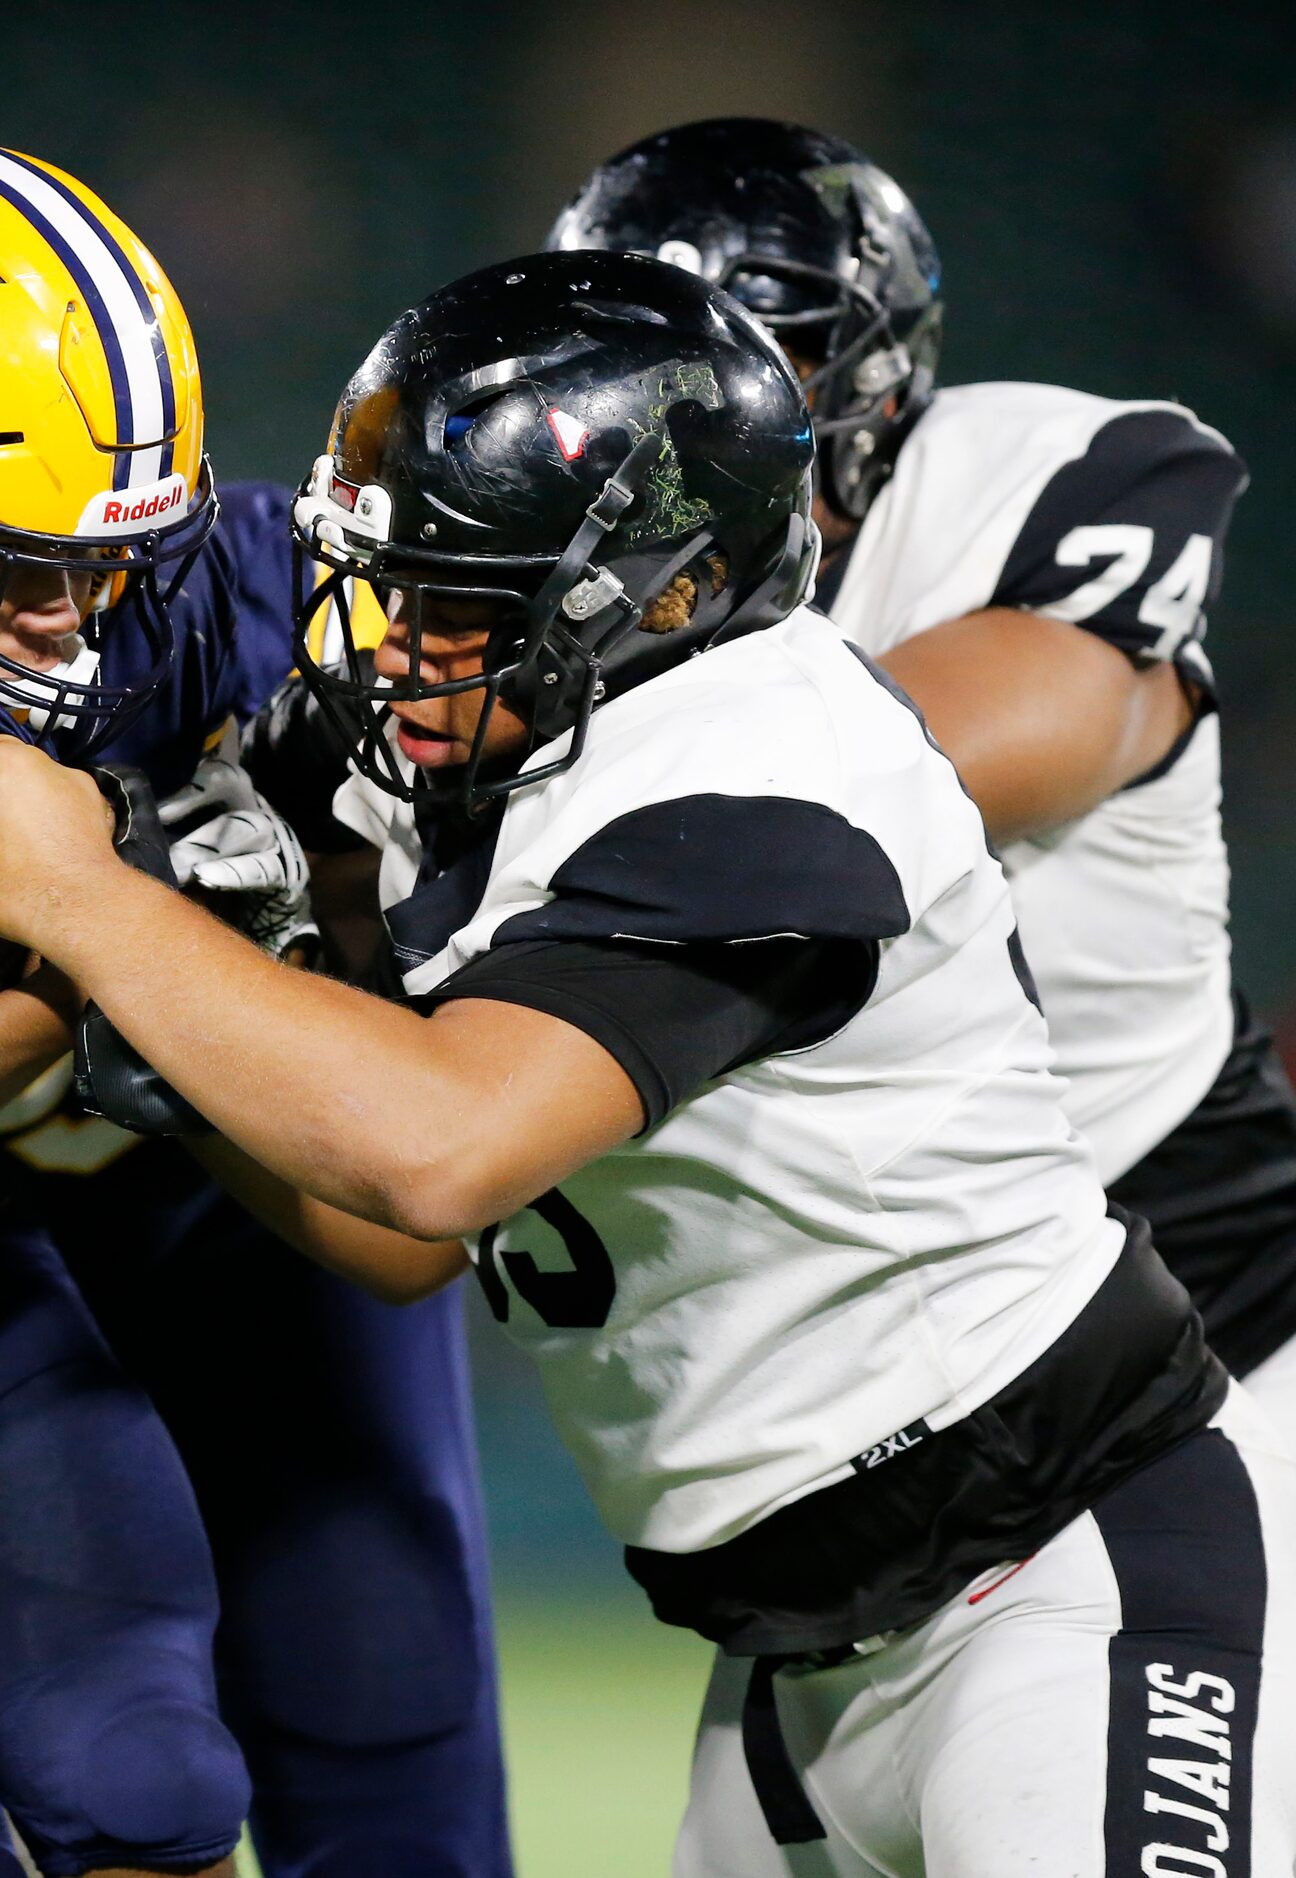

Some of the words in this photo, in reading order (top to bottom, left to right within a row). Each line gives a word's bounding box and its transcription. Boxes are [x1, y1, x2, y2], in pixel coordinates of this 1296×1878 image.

[103, 484, 183, 523] Riddell
[1022, 523, 1213, 661] 24
[860, 1430, 924, 1469] 2XL
